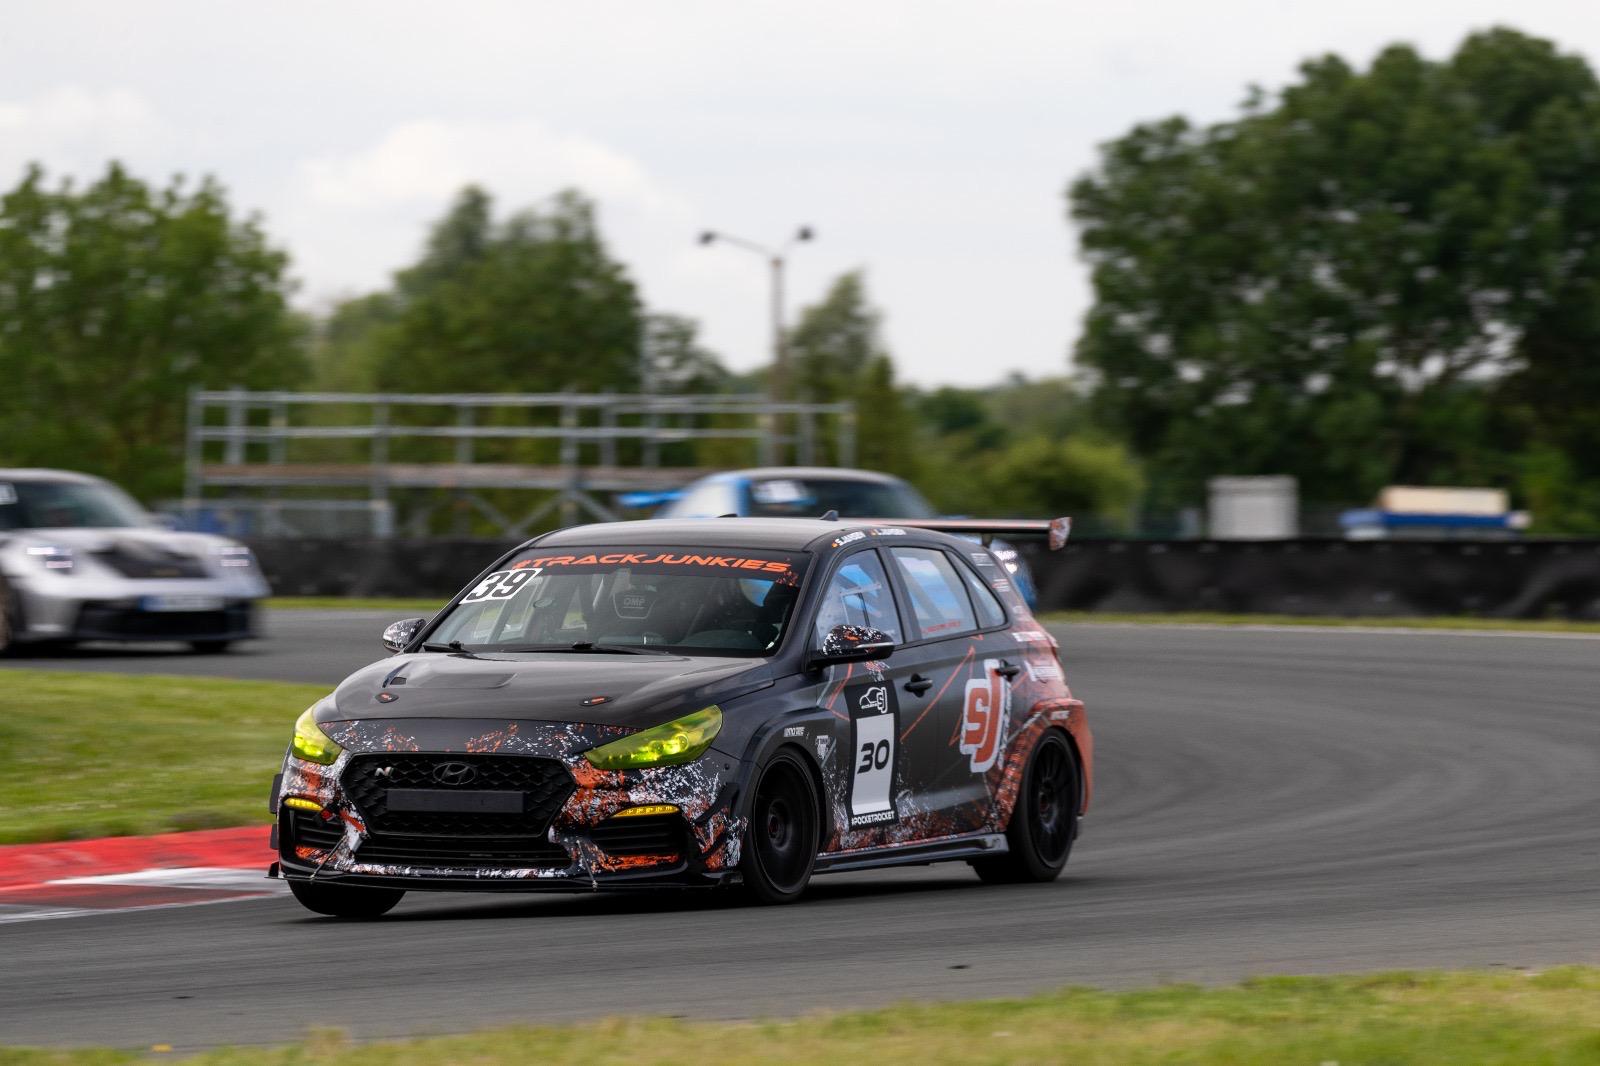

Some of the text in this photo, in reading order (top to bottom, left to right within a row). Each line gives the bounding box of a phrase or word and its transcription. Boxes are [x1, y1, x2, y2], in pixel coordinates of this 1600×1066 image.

[465, 569, 537, 601] 39
[623, 597, 646, 607] OMP
[857, 739, 890, 774] 30
[851, 811, 895, 825] #POCKETROCKET
